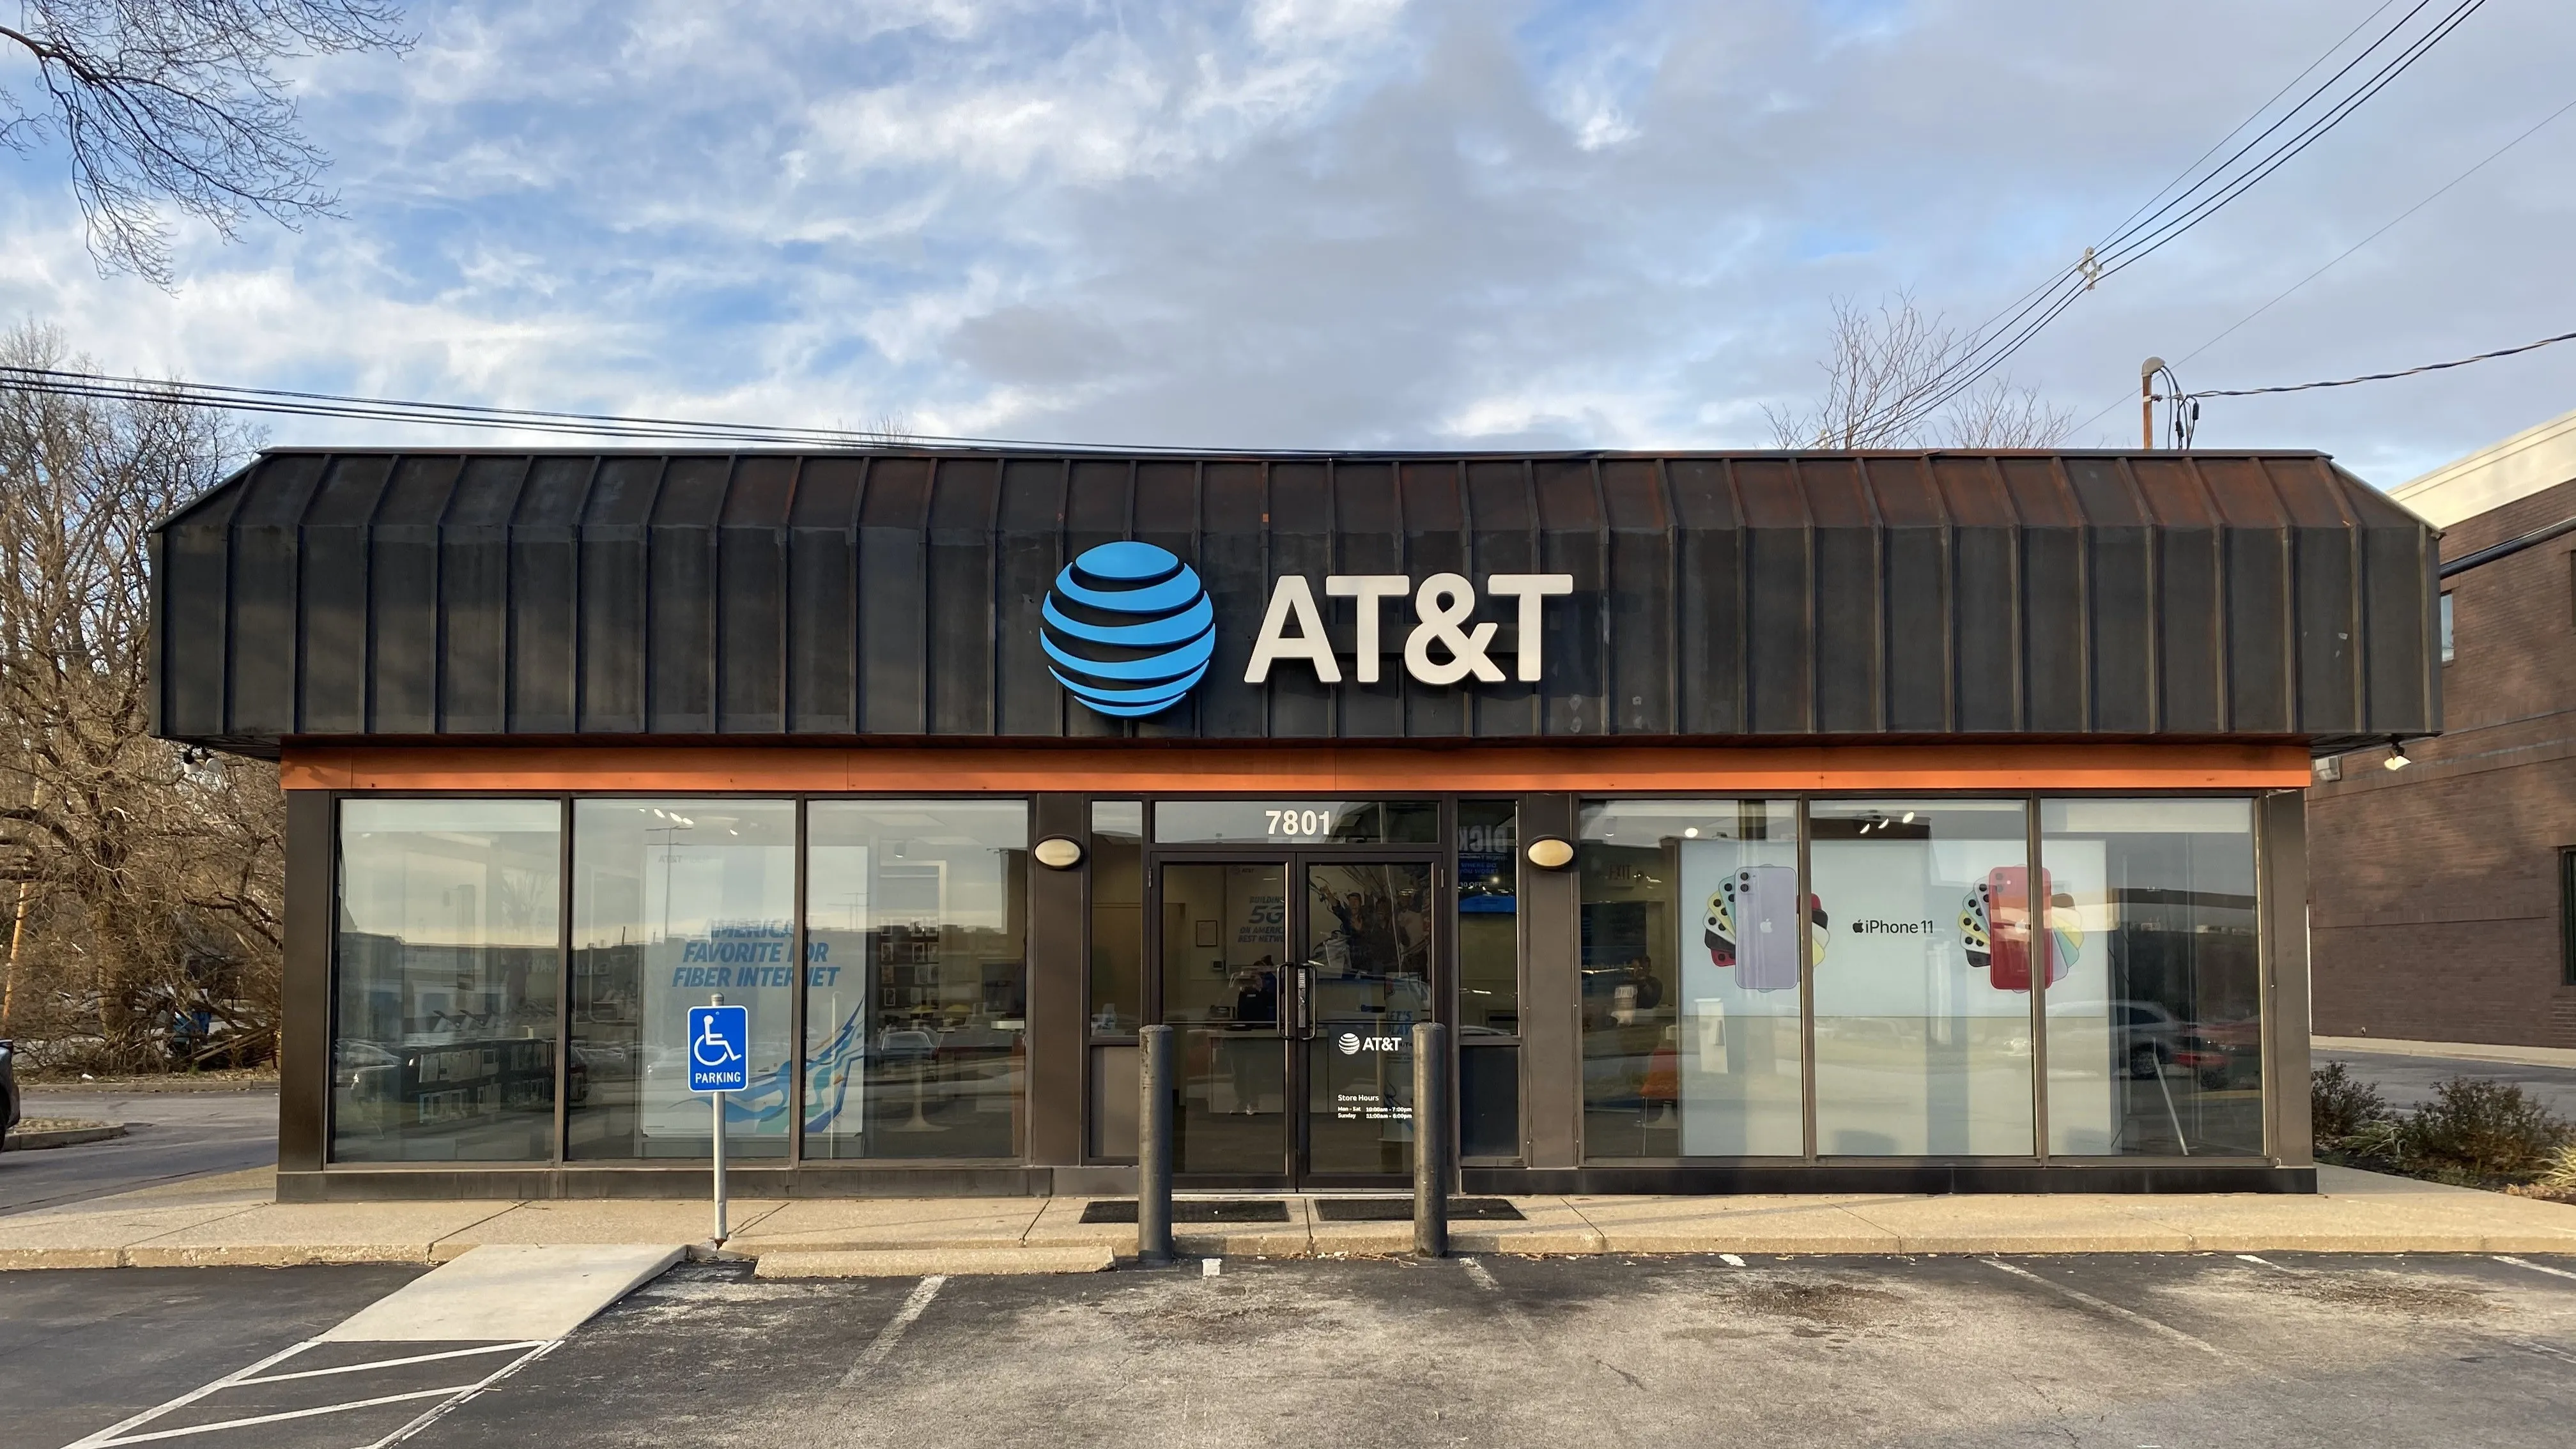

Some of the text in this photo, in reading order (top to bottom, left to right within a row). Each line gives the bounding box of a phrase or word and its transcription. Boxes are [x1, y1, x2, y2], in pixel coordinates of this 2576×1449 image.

[1244, 572, 1573, 685] AT&T
[1265, 809, 1329, 835] 7801
[1248, 905, 1284, 924] 5G
[1865, 920, 1933, 933] iPhone 11
[683, 942, 783, 963] FAVORITE
[672, 967, 732, 987] FIBER
[1362, 1037, 1402, 1051] AT&T
[695, 1071, 741, 1084] PARKING
